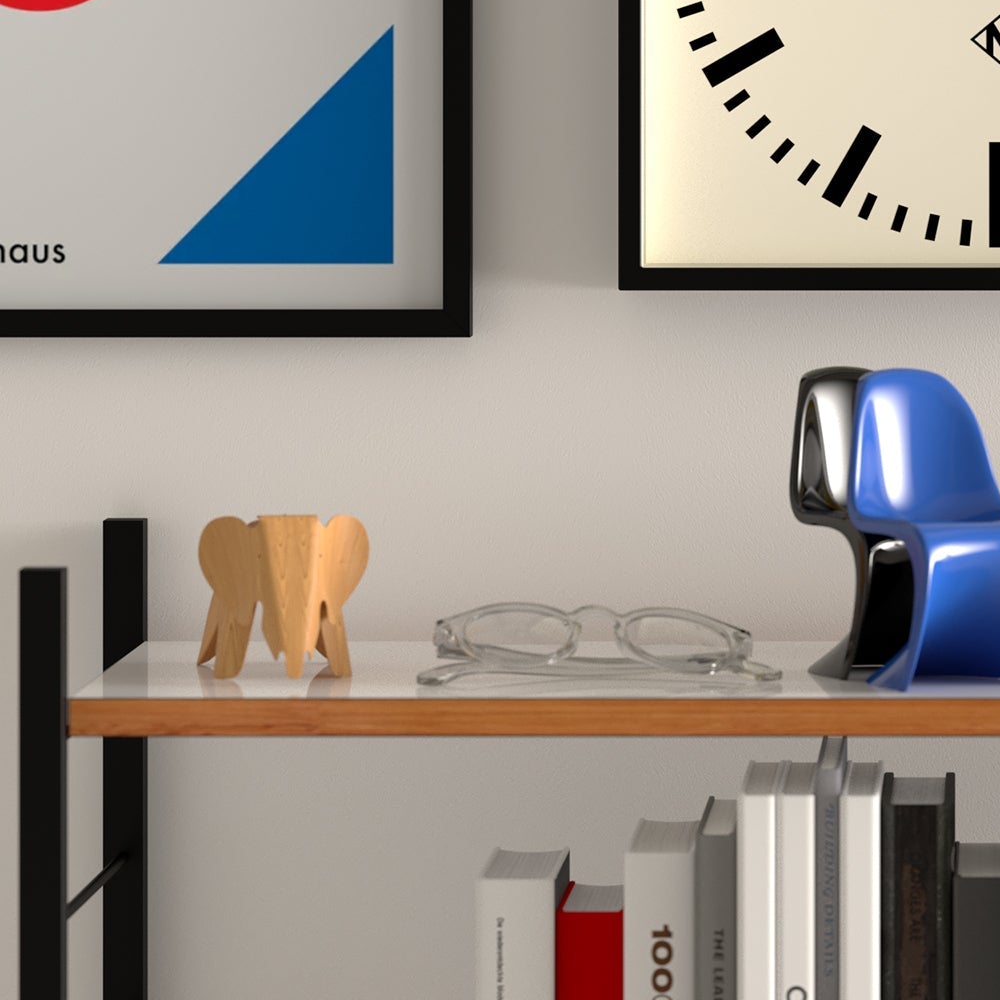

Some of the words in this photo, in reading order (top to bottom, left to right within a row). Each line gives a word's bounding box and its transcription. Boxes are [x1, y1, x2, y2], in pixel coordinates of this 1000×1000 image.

[651, 924, 674, 1000] 100
[713, 928, 725, 962] THE
[823, 904, 835, 978] DETAILS
[713, 967, 725, 1000] LEA
